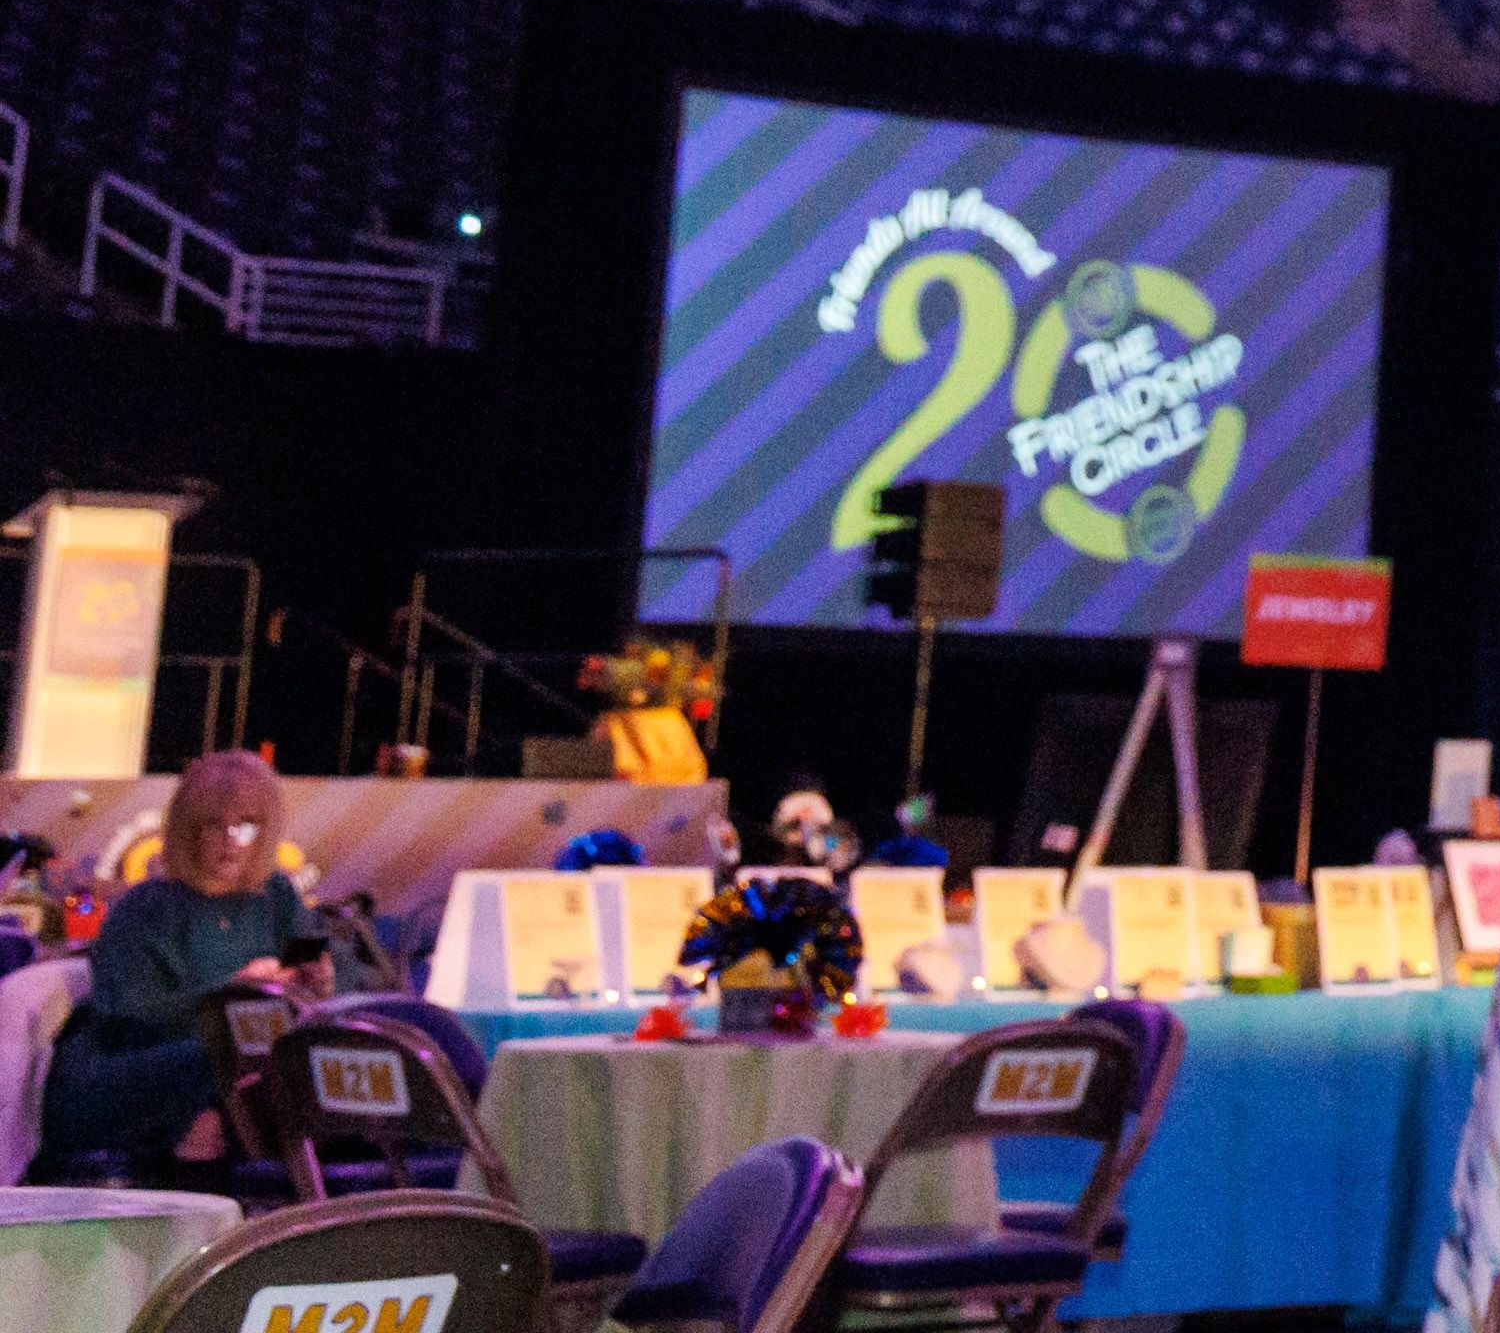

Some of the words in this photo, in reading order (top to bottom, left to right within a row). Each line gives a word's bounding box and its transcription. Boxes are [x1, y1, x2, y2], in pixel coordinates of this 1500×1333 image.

[1074, 325, 1164, 392] THE
[1007, 334, 1243, 477] FRIENDSHIP
[1071, 402, 1207, 495] CIRCLE
[321, 1061, 395, 1102] M2M
[991, 1061, 1081, 1101] M2M
